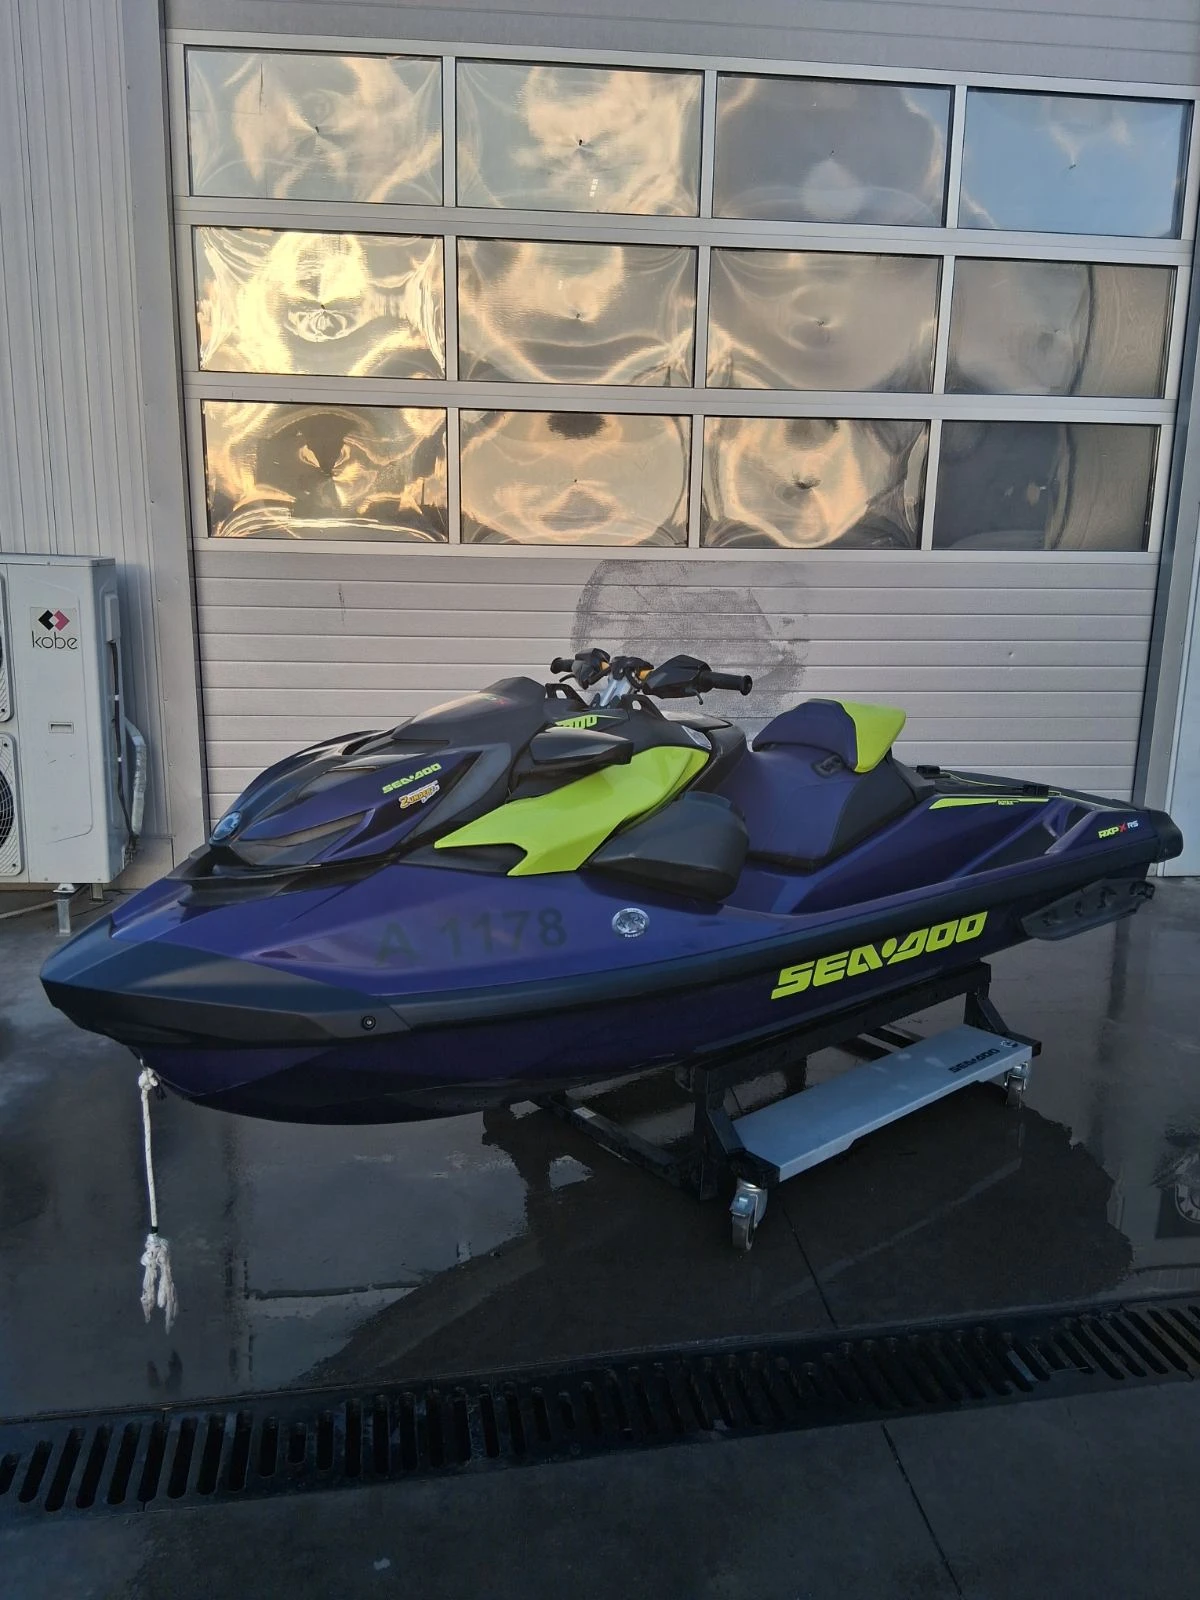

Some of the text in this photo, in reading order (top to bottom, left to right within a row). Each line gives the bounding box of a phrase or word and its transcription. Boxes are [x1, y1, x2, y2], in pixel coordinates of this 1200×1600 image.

[31, 630, 79, 650] kobe
[374, 907, 567, 967] A 1178
